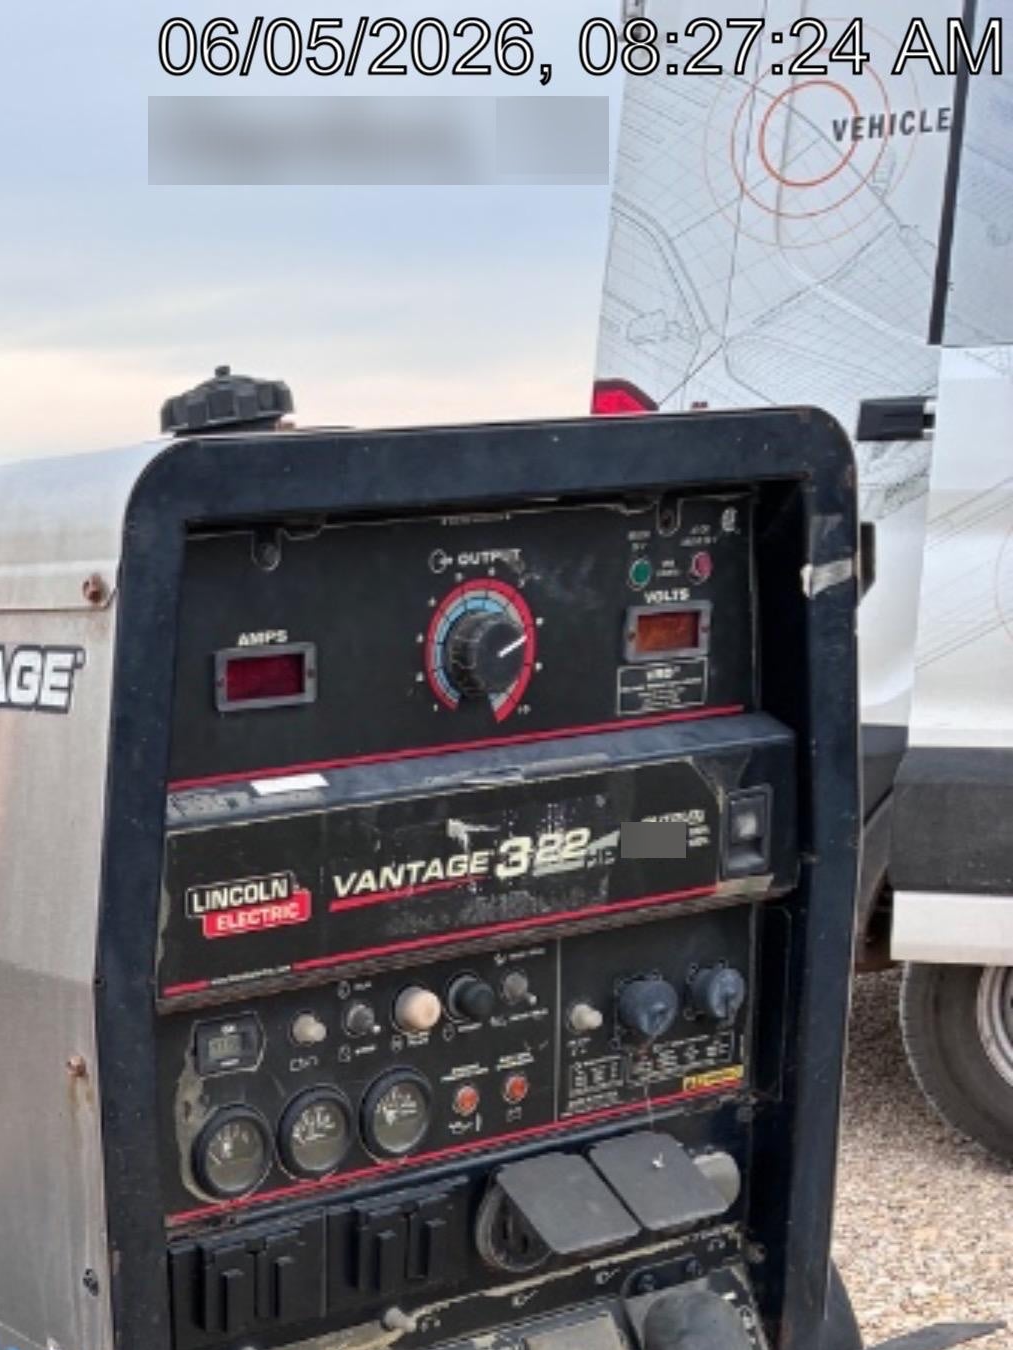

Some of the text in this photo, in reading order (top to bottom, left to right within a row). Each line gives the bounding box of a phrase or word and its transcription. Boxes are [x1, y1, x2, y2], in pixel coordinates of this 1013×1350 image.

[833, 108, 951, 142] VEHICLE
[237, 628, 288, 646] AMPS
[332, 851, 489, 898] VANTAGE
[192, 878, 289, 914] LINCOLN
[217, 902, 300, 932] ELECTRIC
